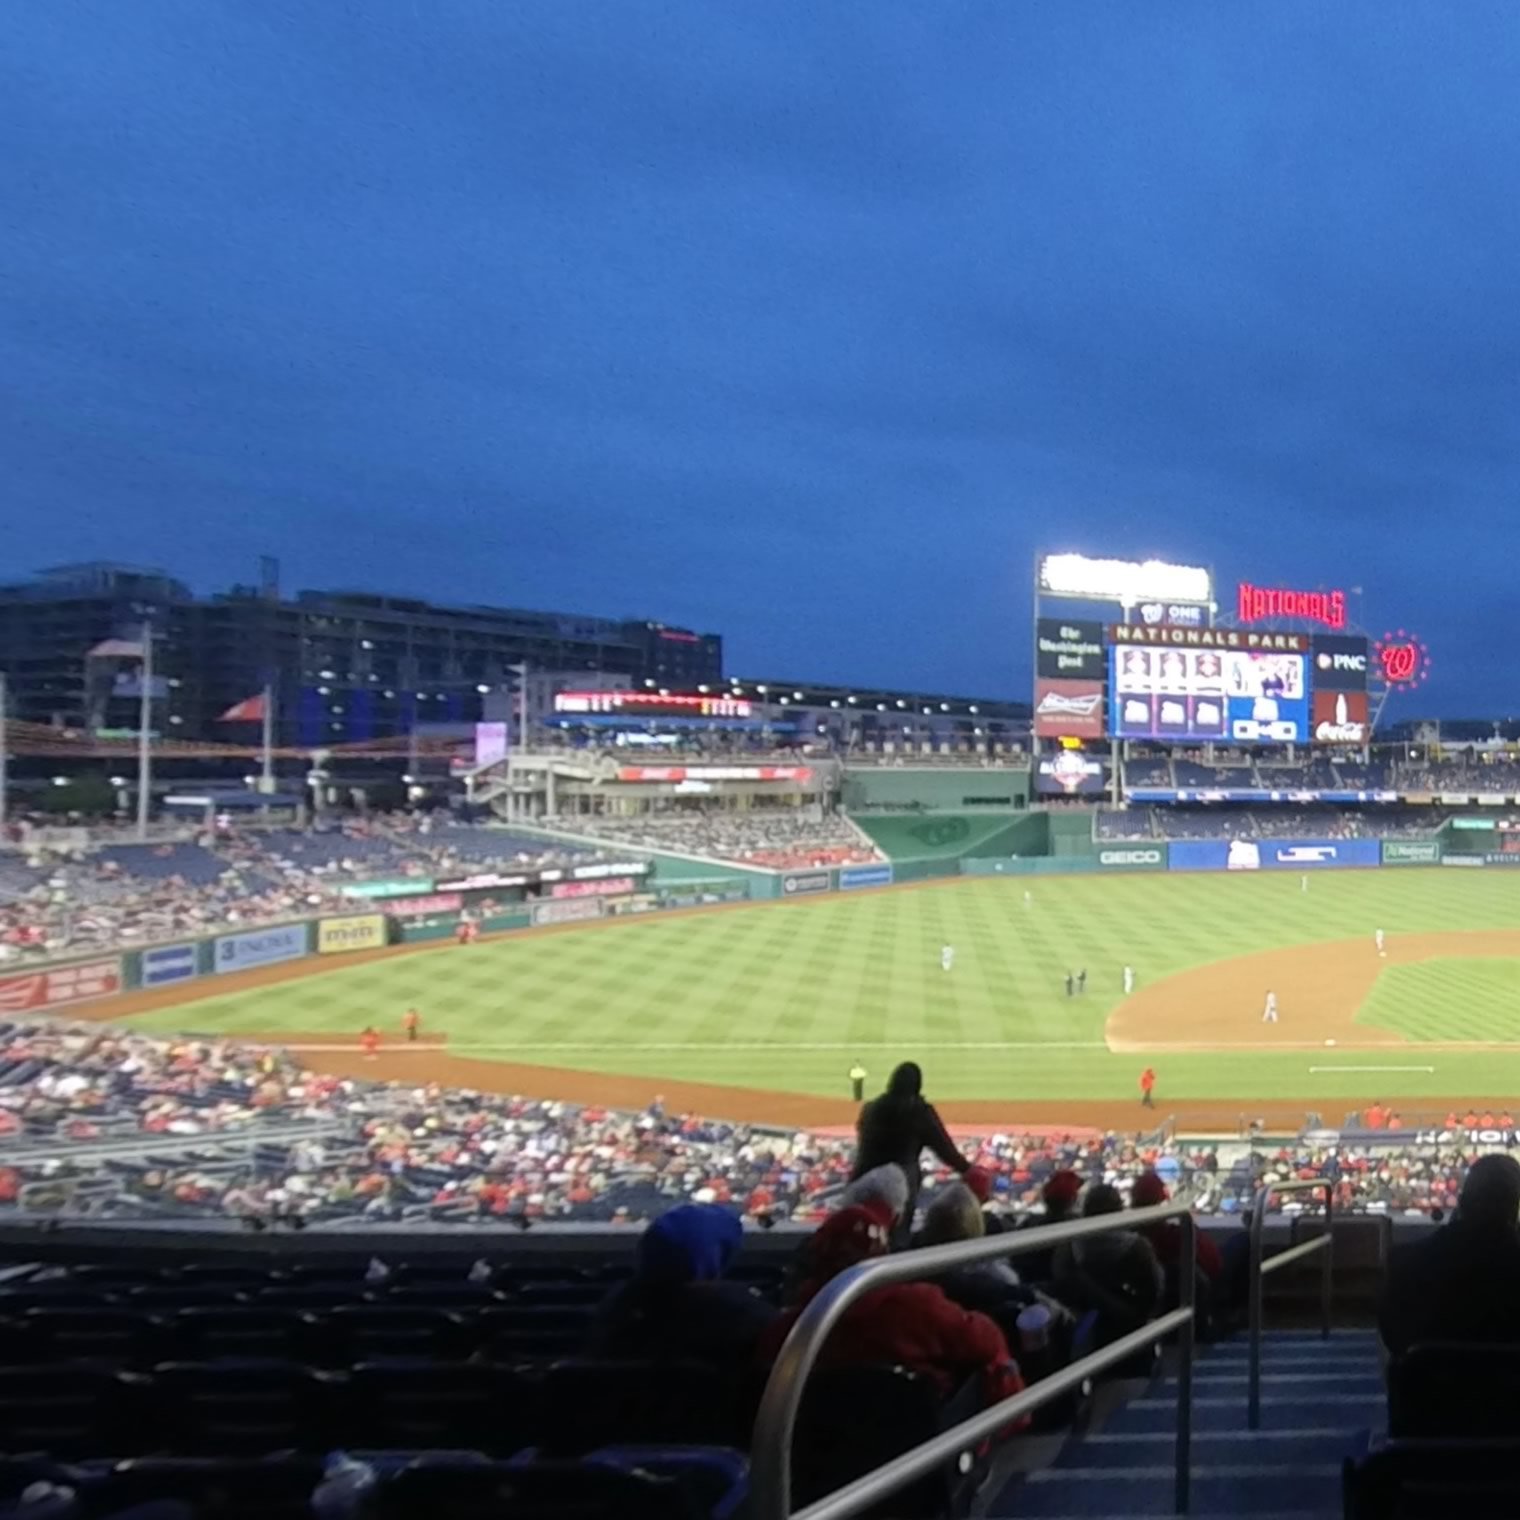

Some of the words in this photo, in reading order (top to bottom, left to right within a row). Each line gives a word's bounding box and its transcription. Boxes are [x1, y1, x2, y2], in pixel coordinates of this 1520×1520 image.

[1239, 583, 1345, 629] NATIONALS
[1116, 626, 1238, 645] NATIONALS
[1248, 634, 1299, 649] PARK
[1334, 654, 1367, 670] PNC
[1099, 850, 1160, 864] GEICO
